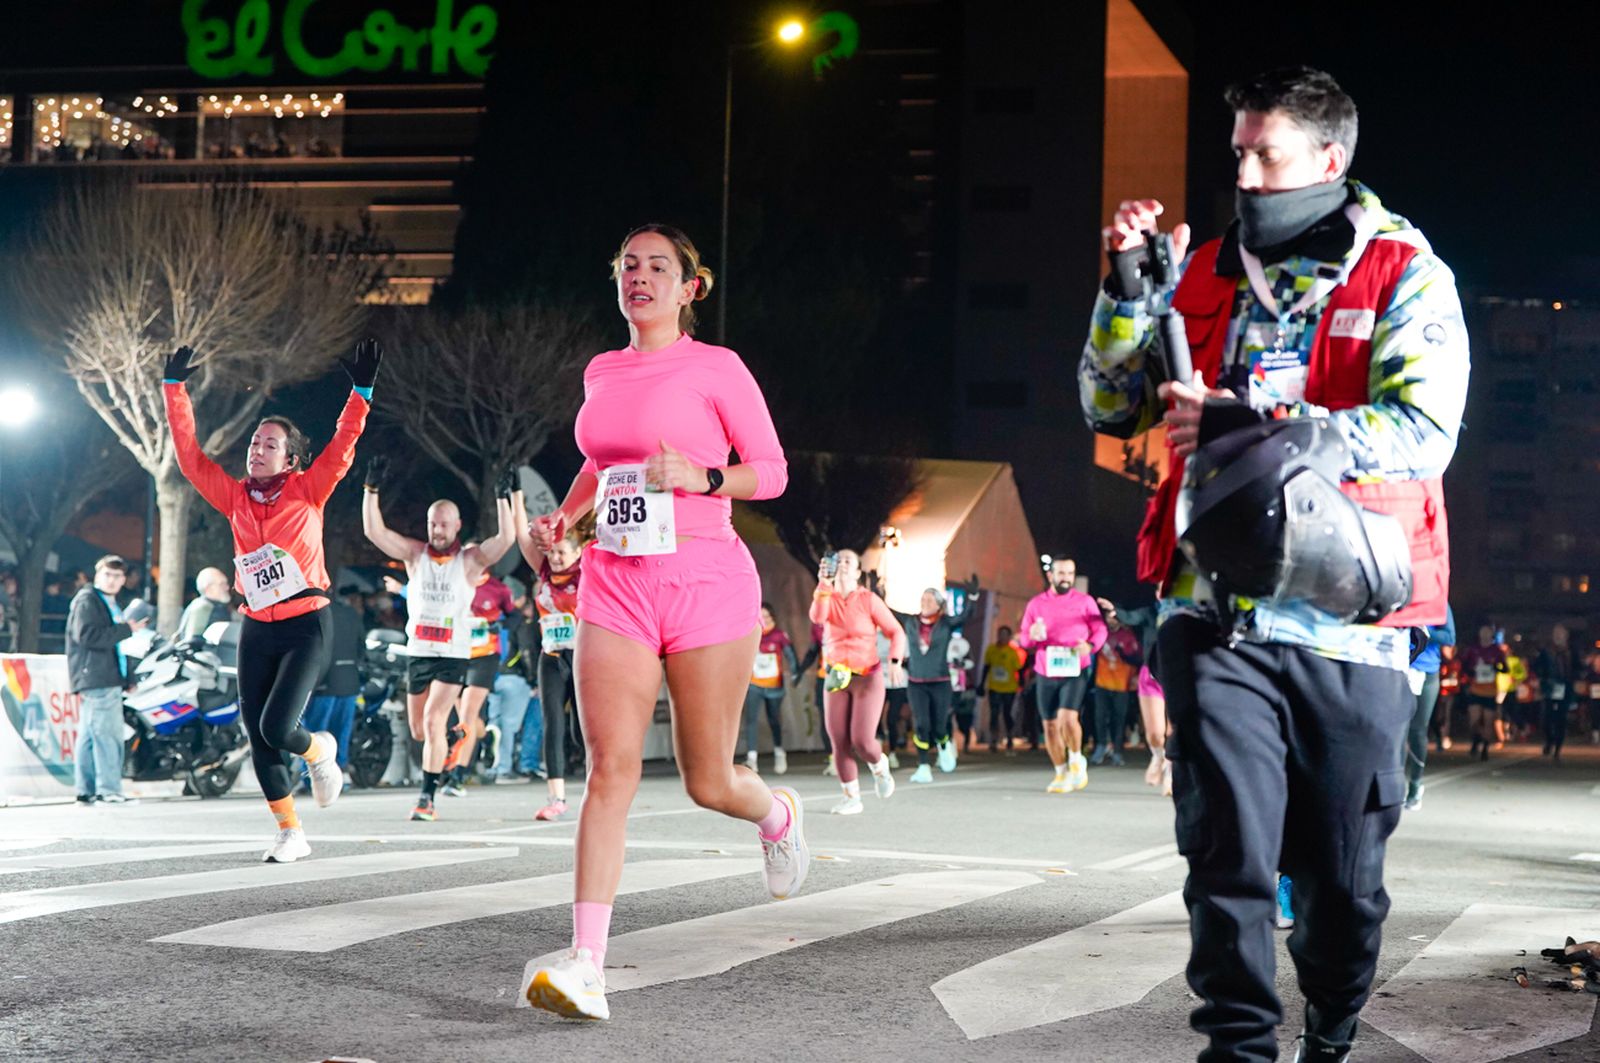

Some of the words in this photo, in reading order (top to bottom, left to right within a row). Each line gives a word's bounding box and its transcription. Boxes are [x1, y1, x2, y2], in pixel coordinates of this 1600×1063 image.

[182, 0, 274, 78] El
[282, 0, 498, 77] Corte
[627, 474, 638, 484] DE
[607, 496, 647, 526] 693
[254, 561, 285, 588] 7347
[61, 730, 77, 761] A
